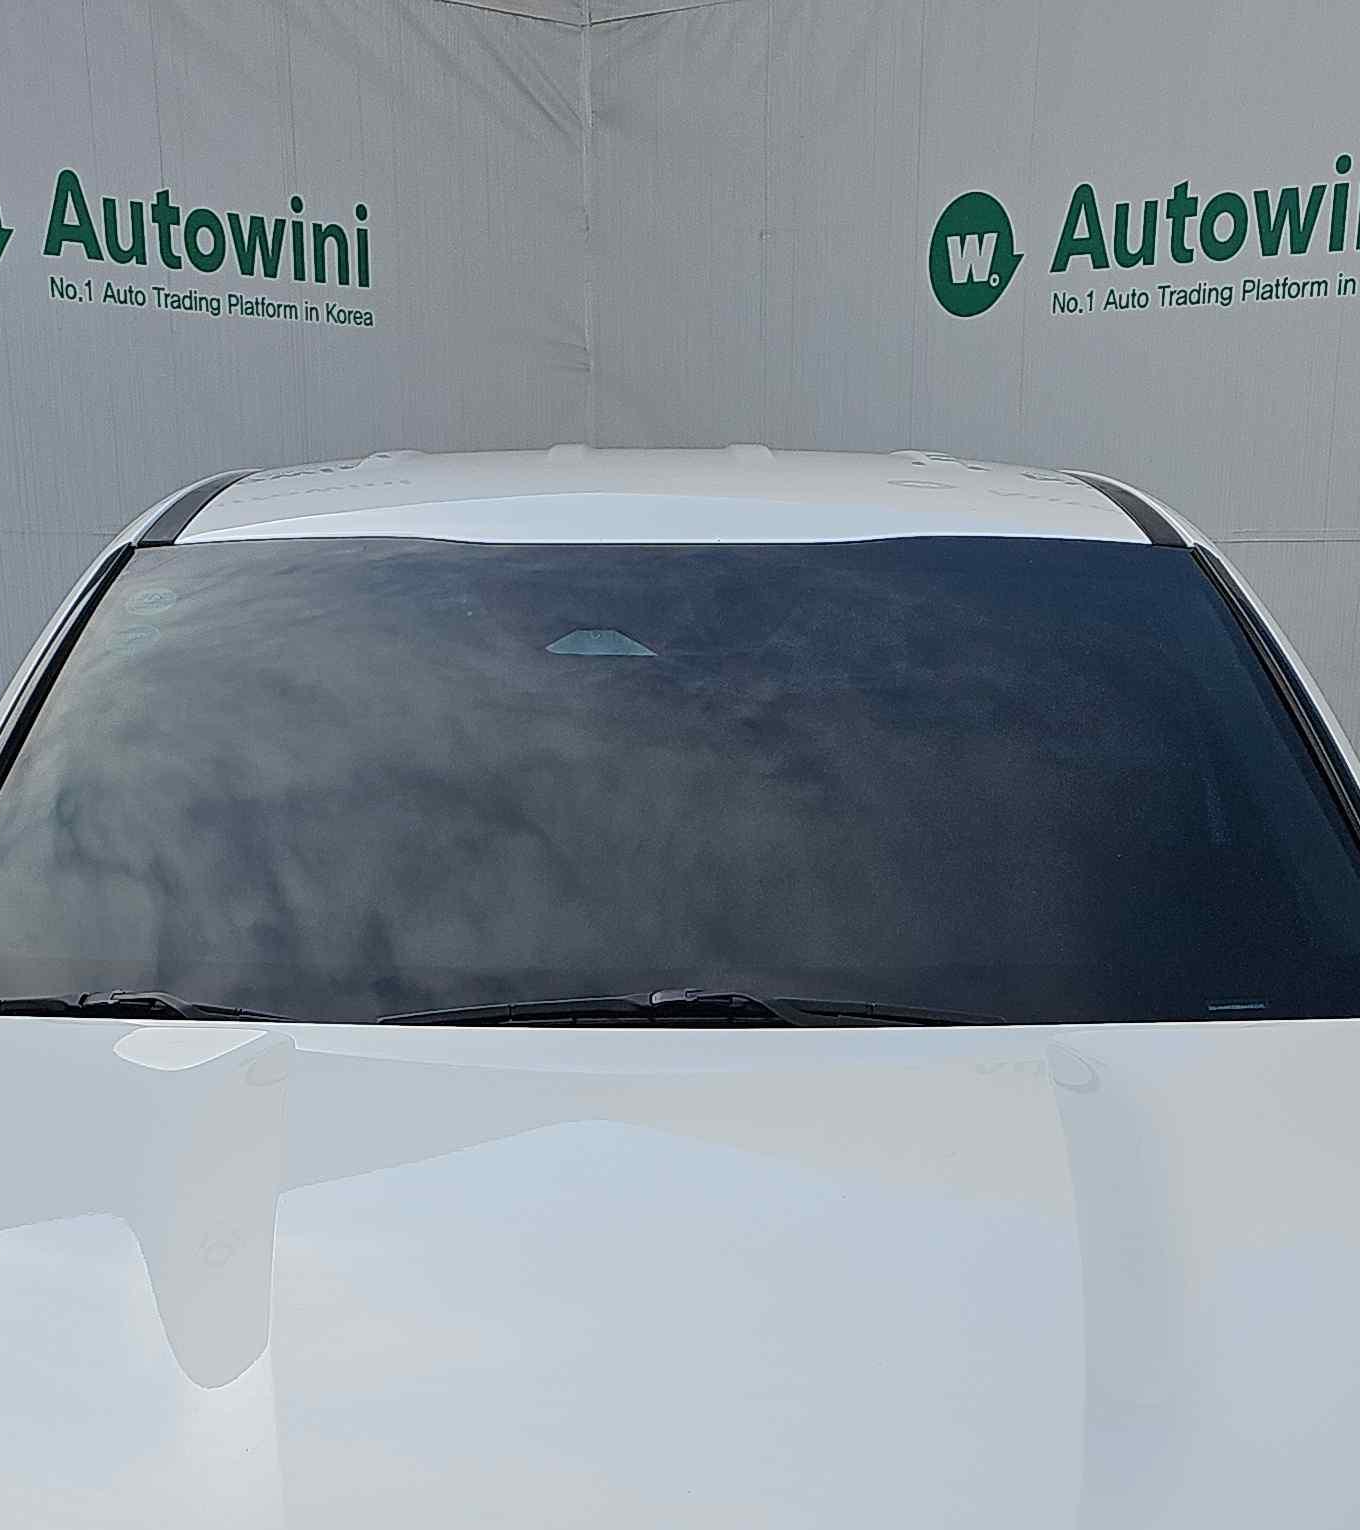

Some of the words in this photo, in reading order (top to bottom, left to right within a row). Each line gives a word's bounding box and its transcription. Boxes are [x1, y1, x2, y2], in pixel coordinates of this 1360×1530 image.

[43, 169, 370, 288] Autowini
[49, 277, 93, 303] No.1
[103, 282, 146, 306] Auto
[152, 286, 221, 316] Trading
[227, 293, 298, 320] Platform
[304, 300, 320, 322] in
[325, 303, 374, 327] Korea
[1051, 290, 1095, 317] No.1
[1103, 288, 1150, 312] Auto
[1157, 280, 1233, 308] Trading
[1241, 275, 1329, 302] Platform
[1337, 272, 1357, 296] in
